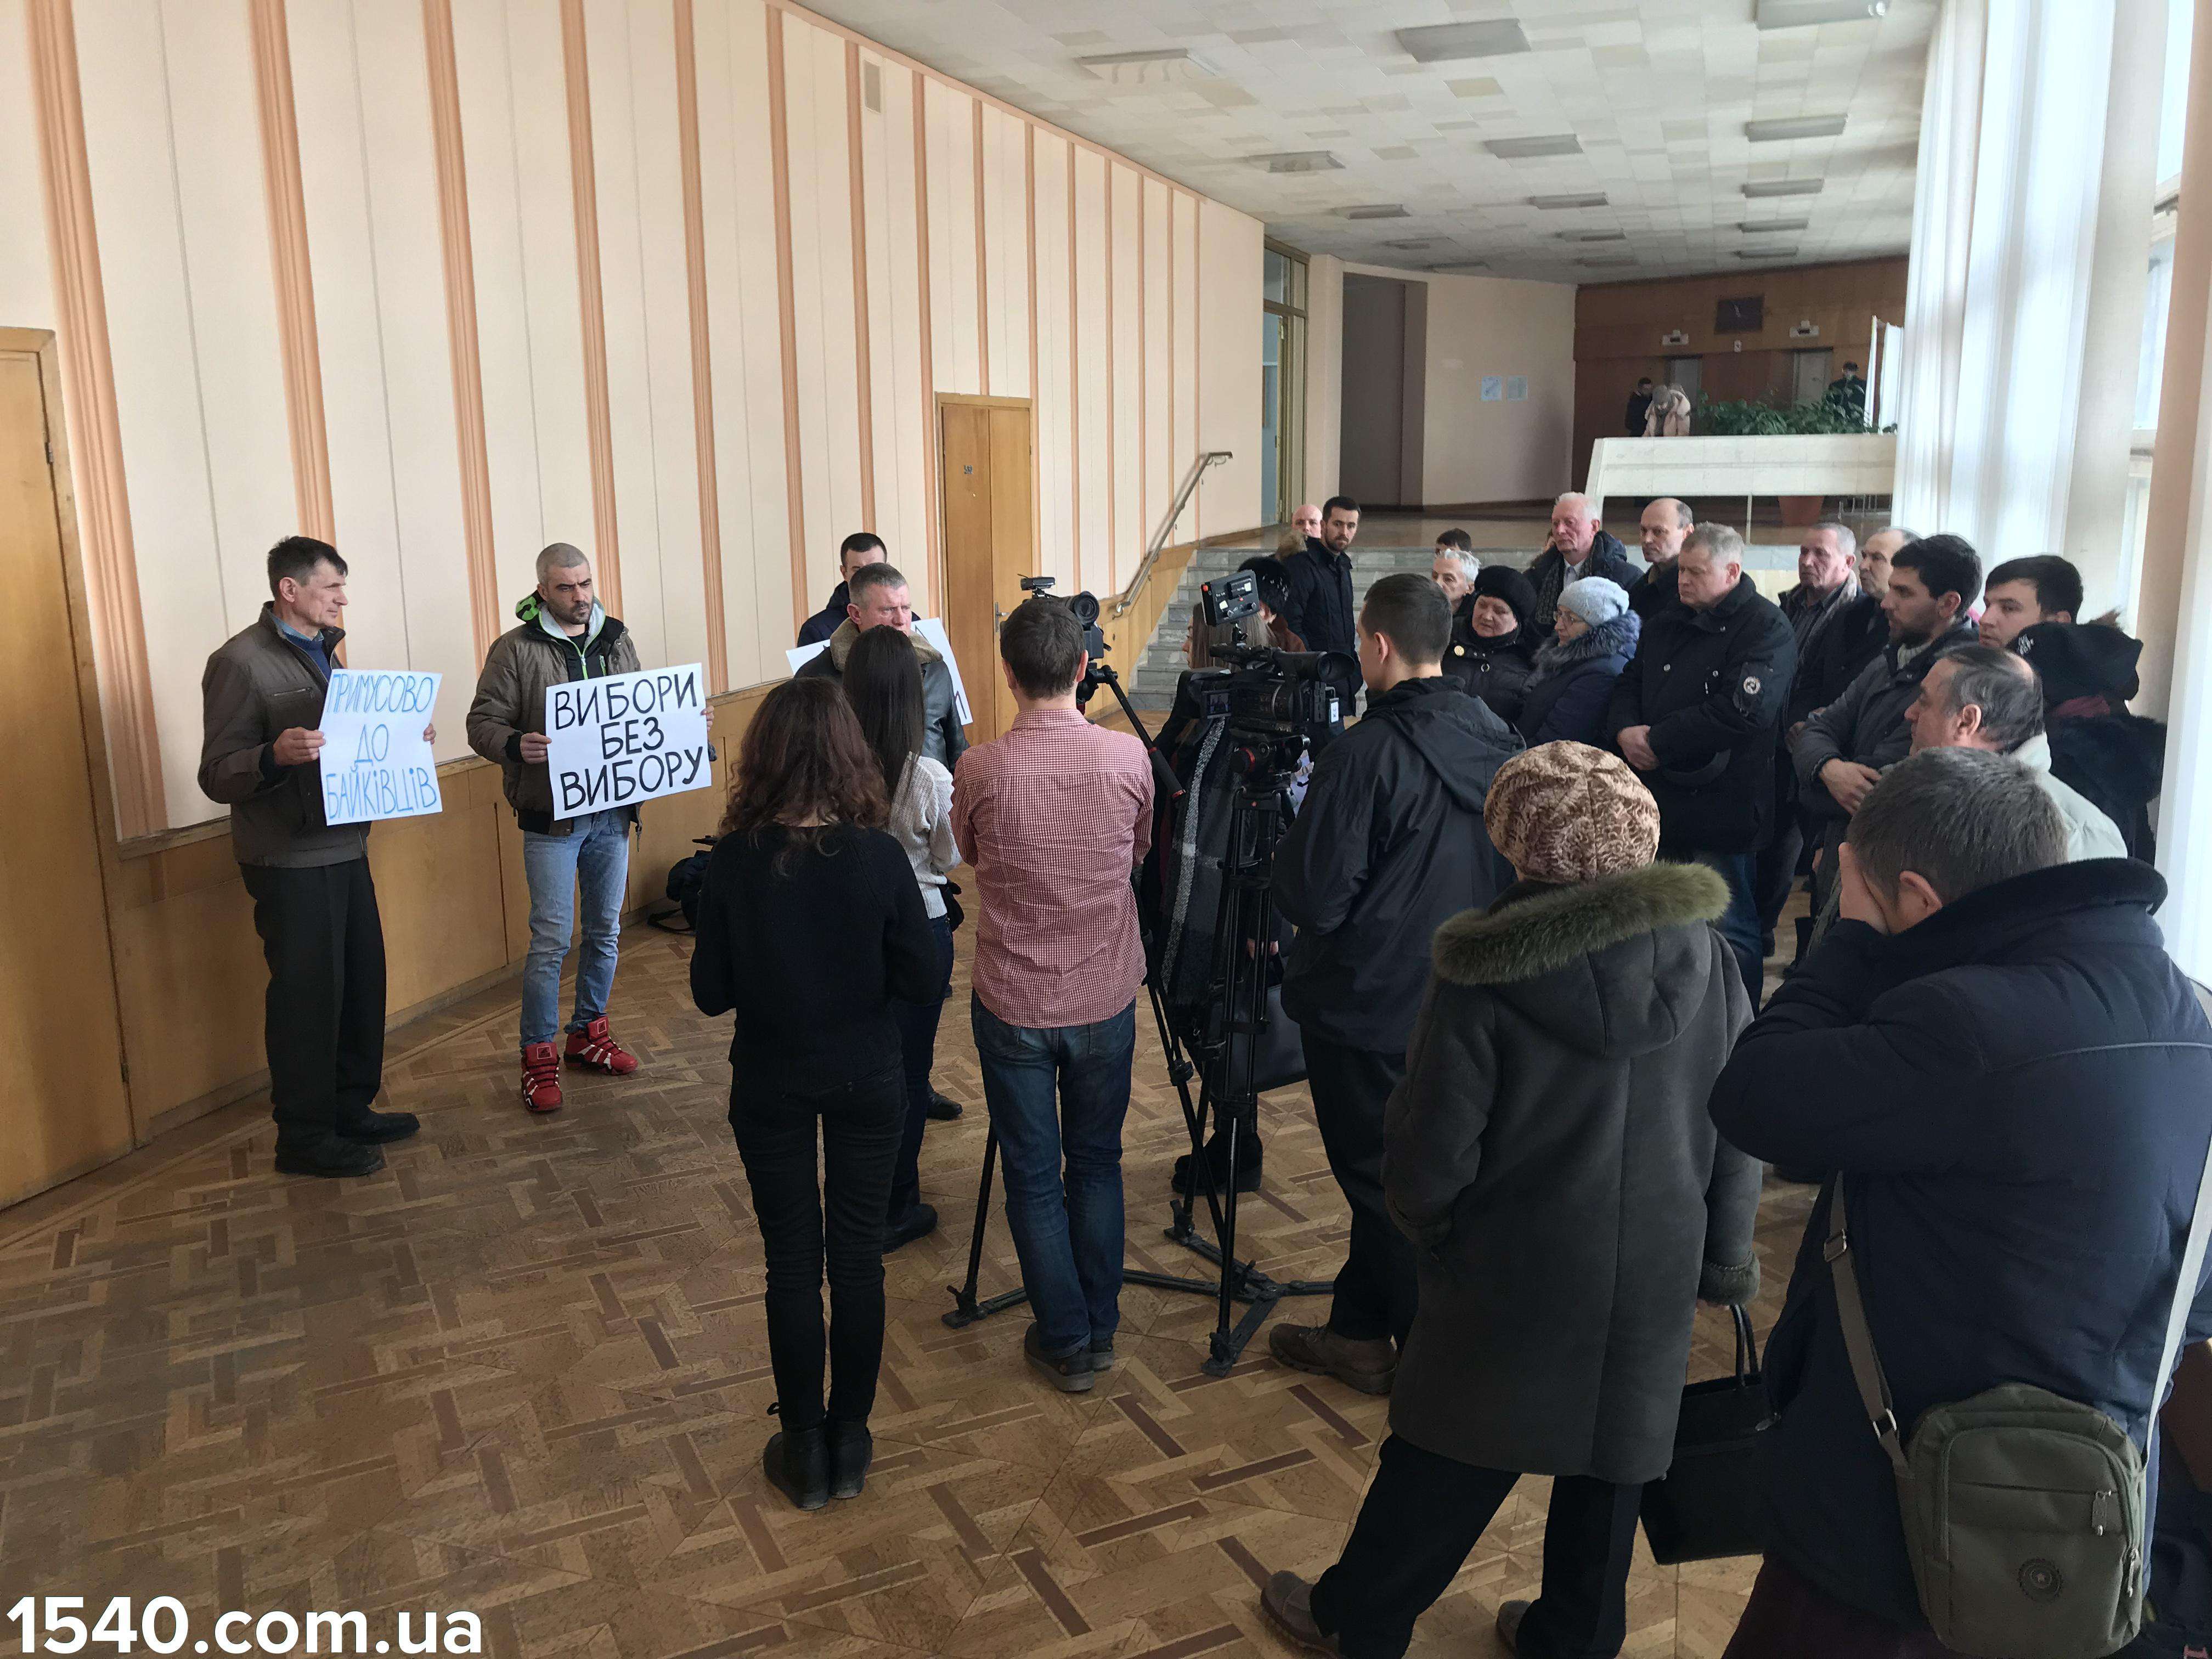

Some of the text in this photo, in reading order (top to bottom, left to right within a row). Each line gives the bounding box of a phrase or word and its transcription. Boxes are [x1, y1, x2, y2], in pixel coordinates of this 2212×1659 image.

[326, 673, 433, 713] ПРИМУСОВО
[555, 672, 697, 730] ВИБОРИ
[354, 724, 389, 766] ДО
[600, 716, 665, 760] БЕЗ
[560, 746, 704, 811] ВИБОРУ
